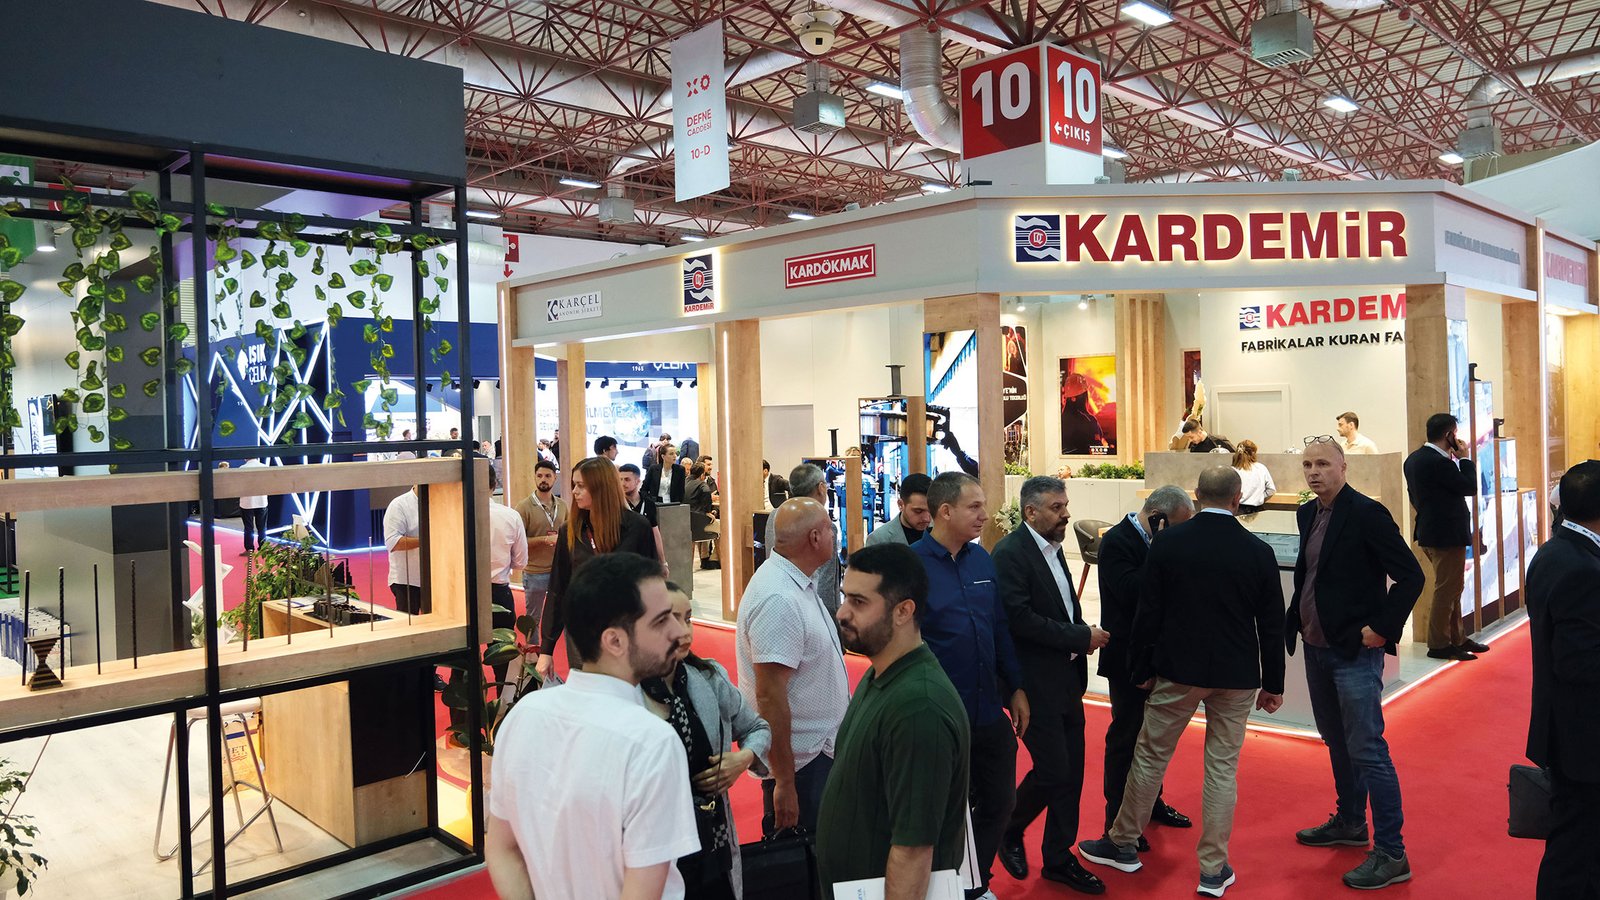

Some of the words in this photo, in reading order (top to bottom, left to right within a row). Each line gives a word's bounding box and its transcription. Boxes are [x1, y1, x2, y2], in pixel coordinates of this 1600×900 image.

[972, 62, 1030, 127] 10
[1057, 61, 1096, 124] 10
[687, 109, 711, 127] DEFNE
[687, 120, 712, 136] CADDESİ
[1064, 124, 1090, 144] ÇIKIŞ
[691, 145, 710, 159] 10-D
[790, 254, 869, 280] KARDÖKMAK
[559, 294, 599, 309] KARÇEL
[1241, 336, 1325, 351] FABRİKALAR
[1329, 332, 1380, 345] KURAN
[248, 343, 266, 365] IŞIK
[248, 363, 267, 385] ÇELİK
